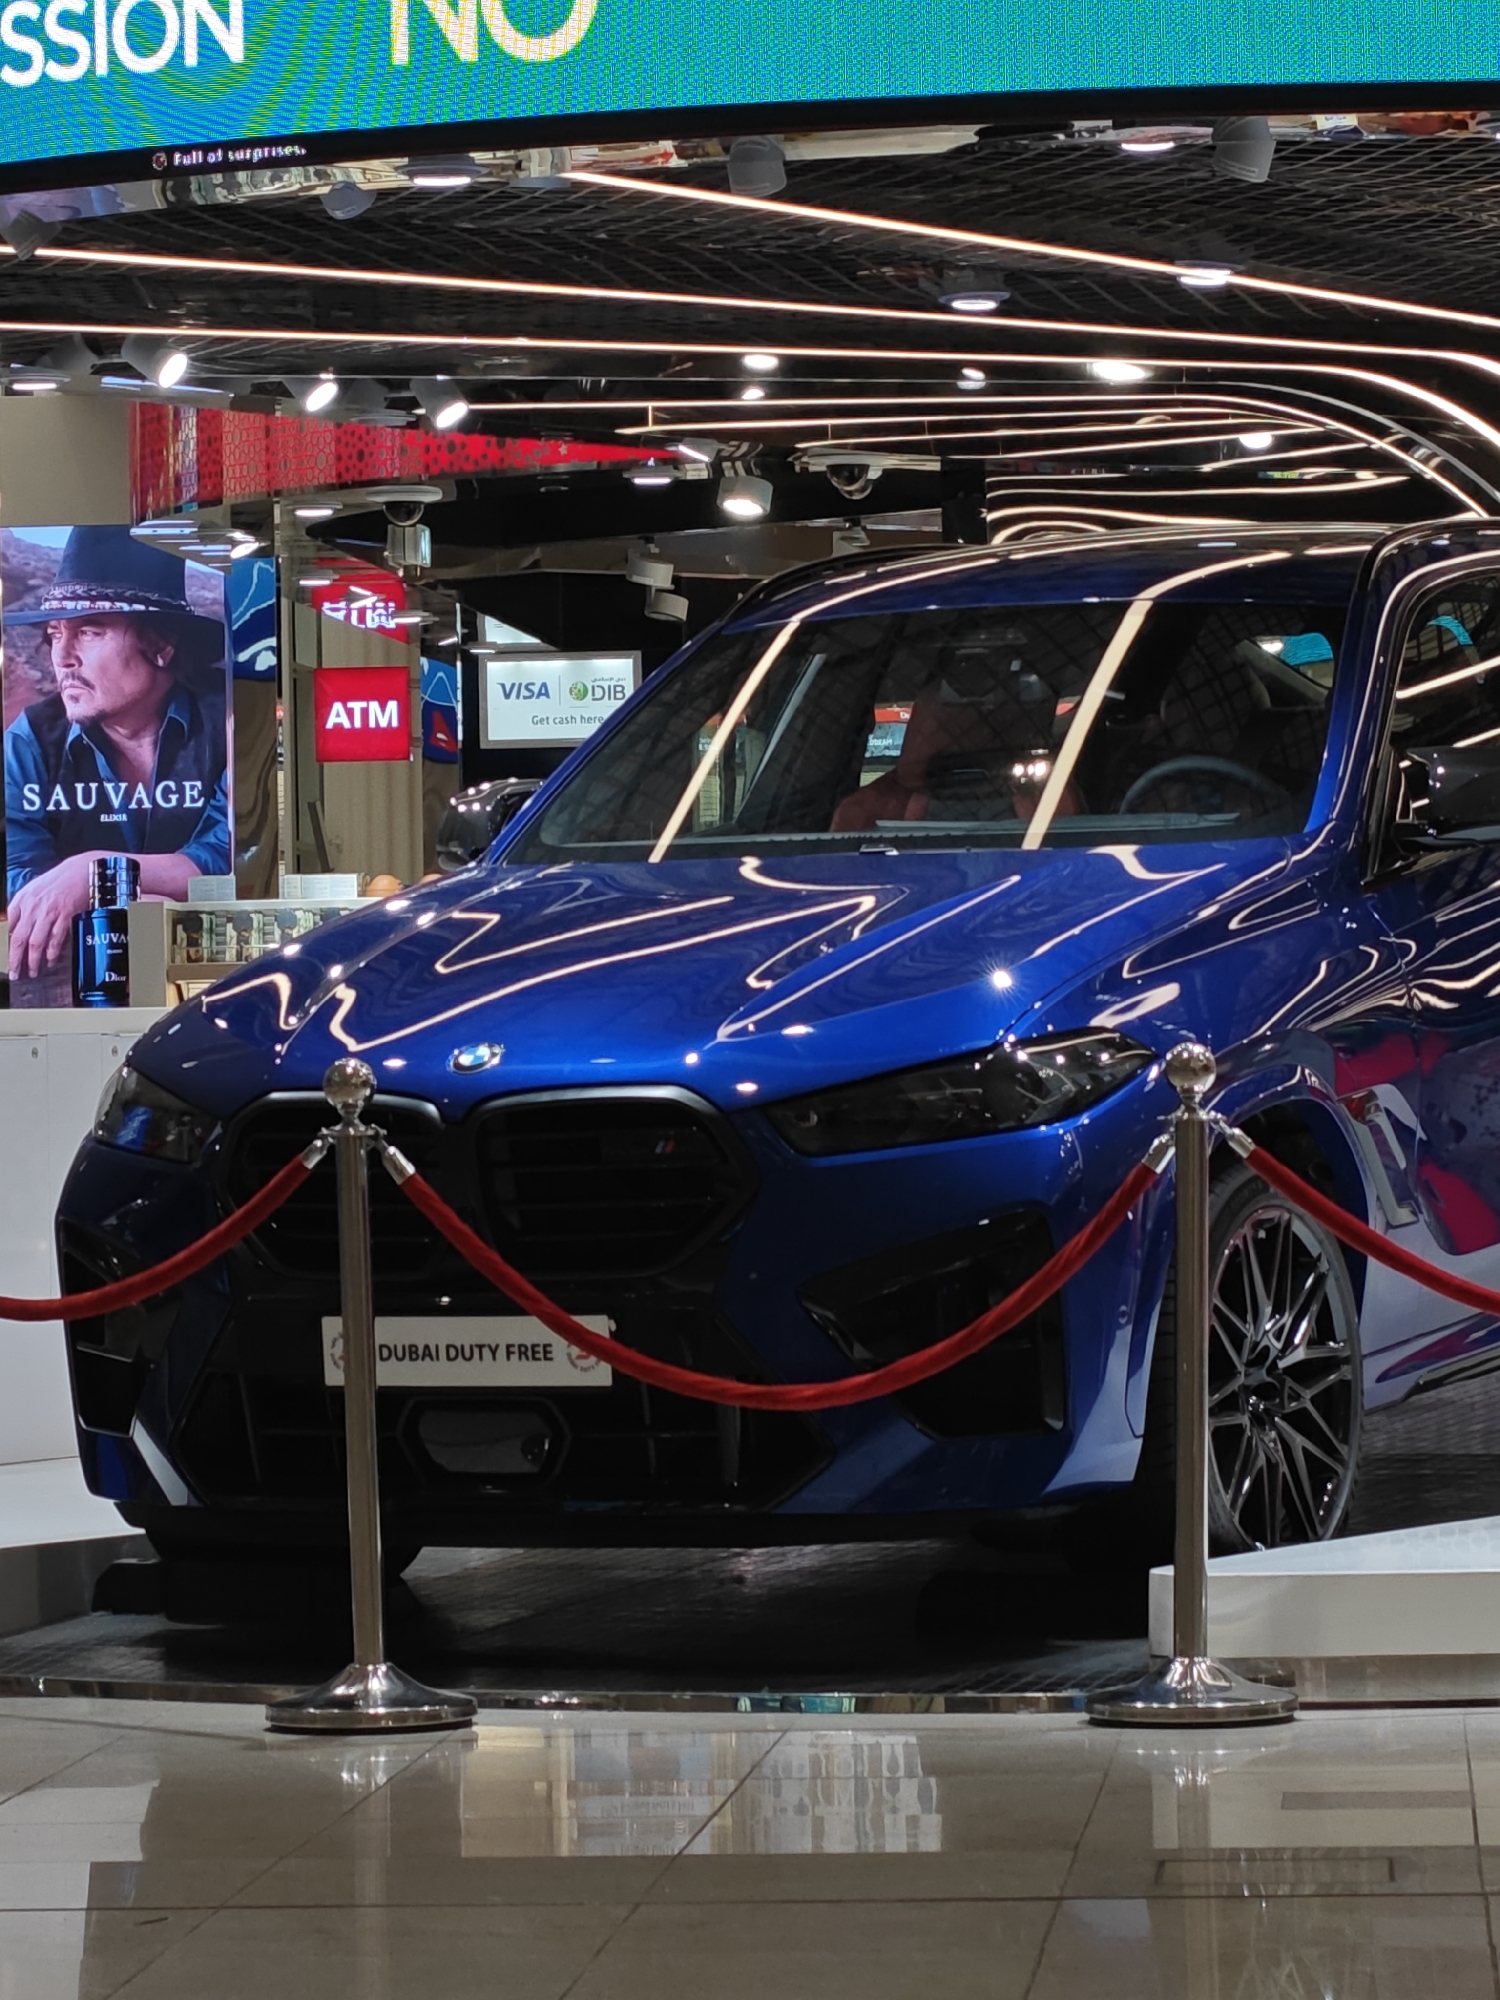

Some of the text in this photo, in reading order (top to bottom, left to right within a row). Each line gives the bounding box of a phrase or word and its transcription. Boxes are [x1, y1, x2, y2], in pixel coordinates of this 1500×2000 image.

[496, 681, 626, 701] VISA DIB
[325, 700, 399, 729] ATM
[531, 714, 605, 725] Get cash here
[22, 780, 205, 811] SAUVAGE
[85, 932, 129, 946] SAUVA
[378, 1343, 440, 1362] DUBAI
[445, 1343, 500, 1362] DUTY
[505, 1343, 554, 1362] FREE
